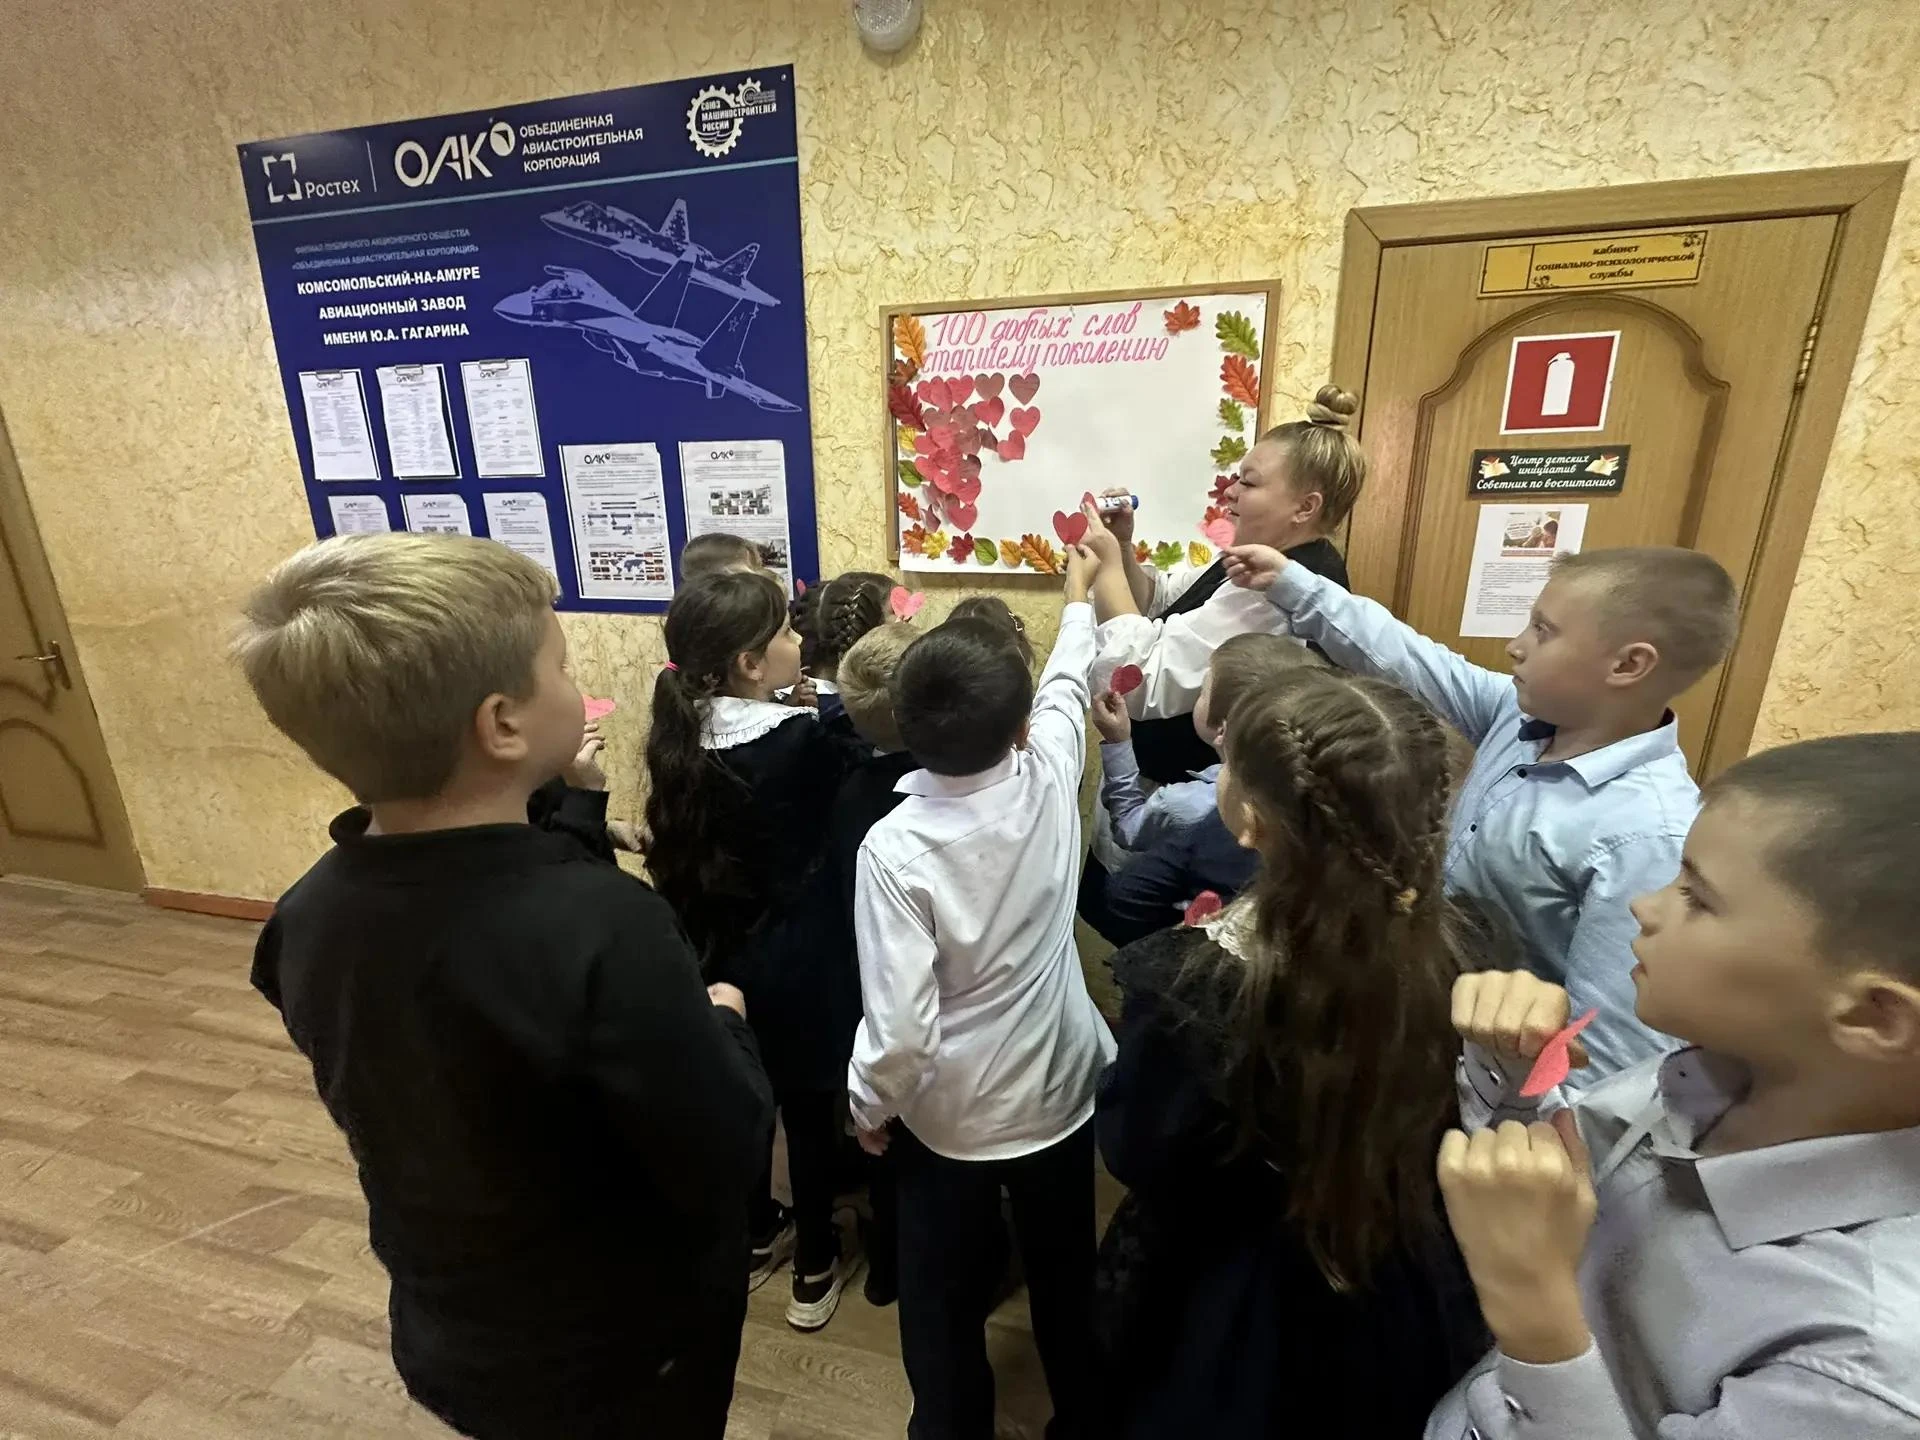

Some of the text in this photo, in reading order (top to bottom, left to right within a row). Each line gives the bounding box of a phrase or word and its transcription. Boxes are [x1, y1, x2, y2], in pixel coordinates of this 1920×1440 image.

[701, 104, 777, 121] МАШИНОСТРОИТЕЛЕЙ
[519, 113, 615, 139] ОБЪЕДИНЕННАЯ
[702, 121, 730, 132] РОССИИ
[521, 128, 644, 156] АВИАСТРОИТЕЛЬНАЯ
[394, 132, 494, 188] ОАК
[523, 151, 601, 173] КОРПОРАЦИЯ
[305, 178, 361, 200] Ростех
[429, 227, 471, 241] ОБЩЕСТВА
[1592, 243, 1641, 256] кабинет
[1535, 251, 1696, 272] социально-психологической
[297, 266, 481, 295] КОМСОМОЛЬСКИЙ-НА-АМУРЕ
[1589, 269, 1635, 281] службы
[319, 295, 467, 320] АВИАЦИОННЫЙ ЗАВОД
[323, 322, 470, 346] ИМЕНИ Ю.А. ГАГАРИНА
[932, 302, 1143, 348] 100 добрых слов
[921, 336, 1170, 376] старшему поколению
[1510, 454, 1590, 468] Центр детских
[1518, 464, 1578, 477] инициатив
[1476, 477, 1617, 490] Советник по воспитанию
